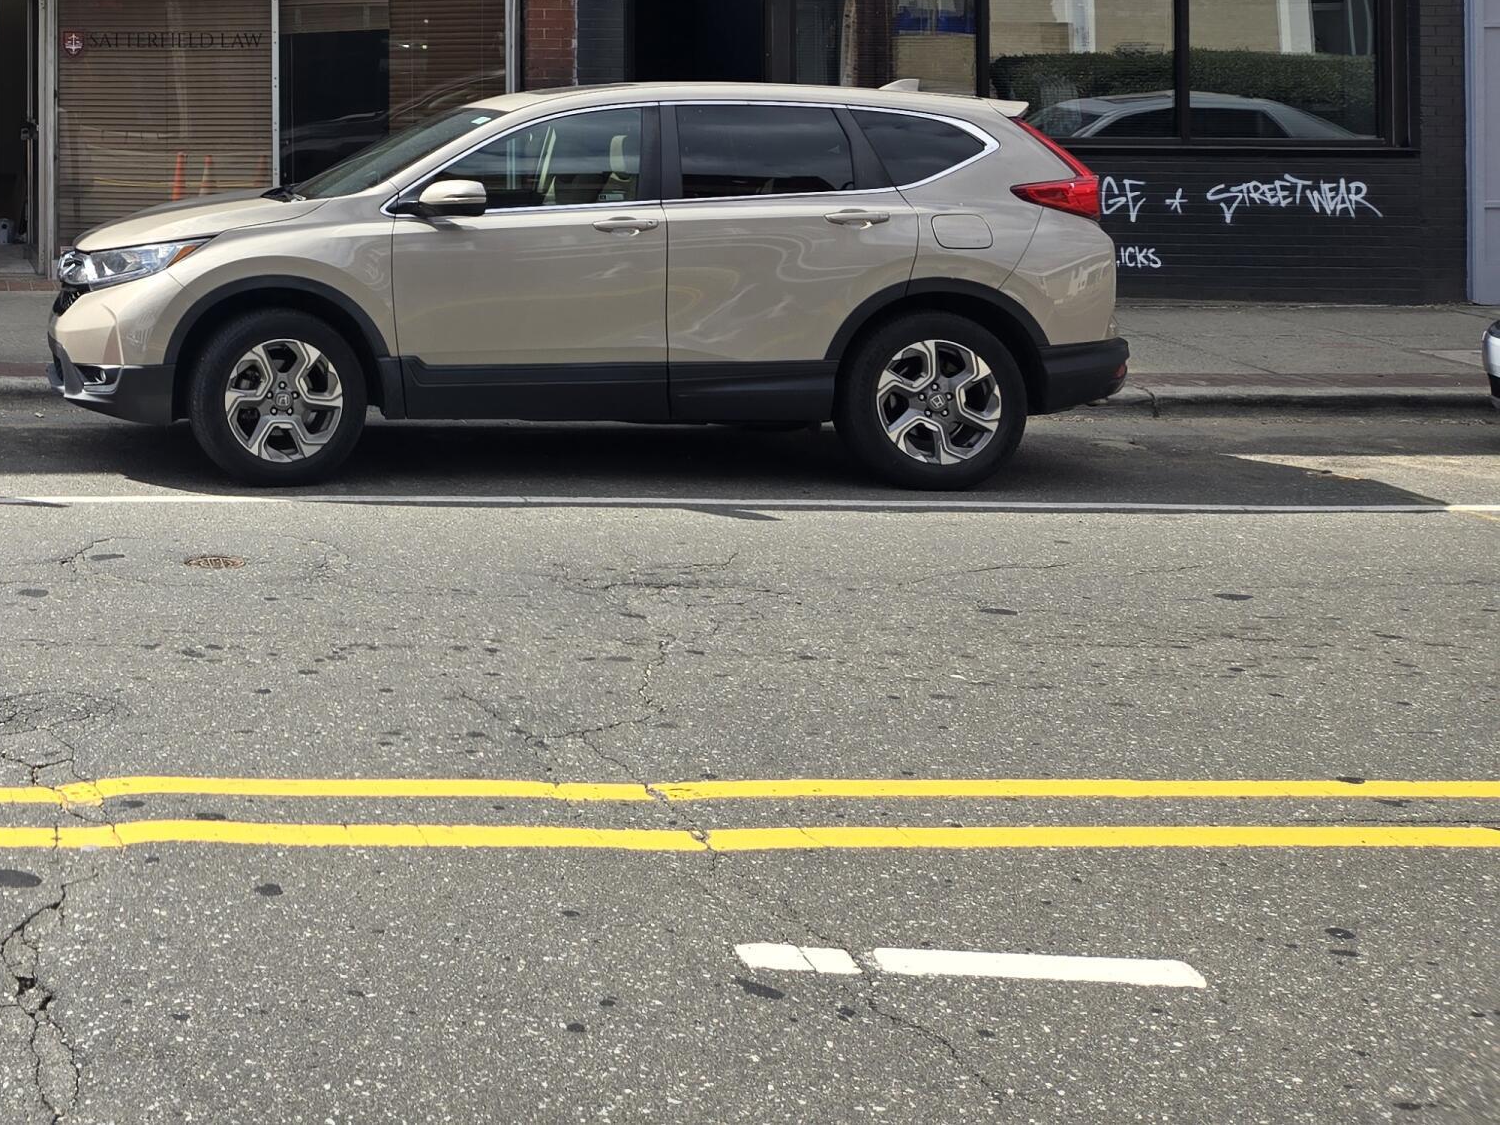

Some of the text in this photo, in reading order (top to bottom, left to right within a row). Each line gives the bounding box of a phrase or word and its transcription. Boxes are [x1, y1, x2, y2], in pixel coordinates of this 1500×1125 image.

[88, 32, 263, 49] SATTERFIELD LAW
[1116, 246, 1162, 268] ICKS
